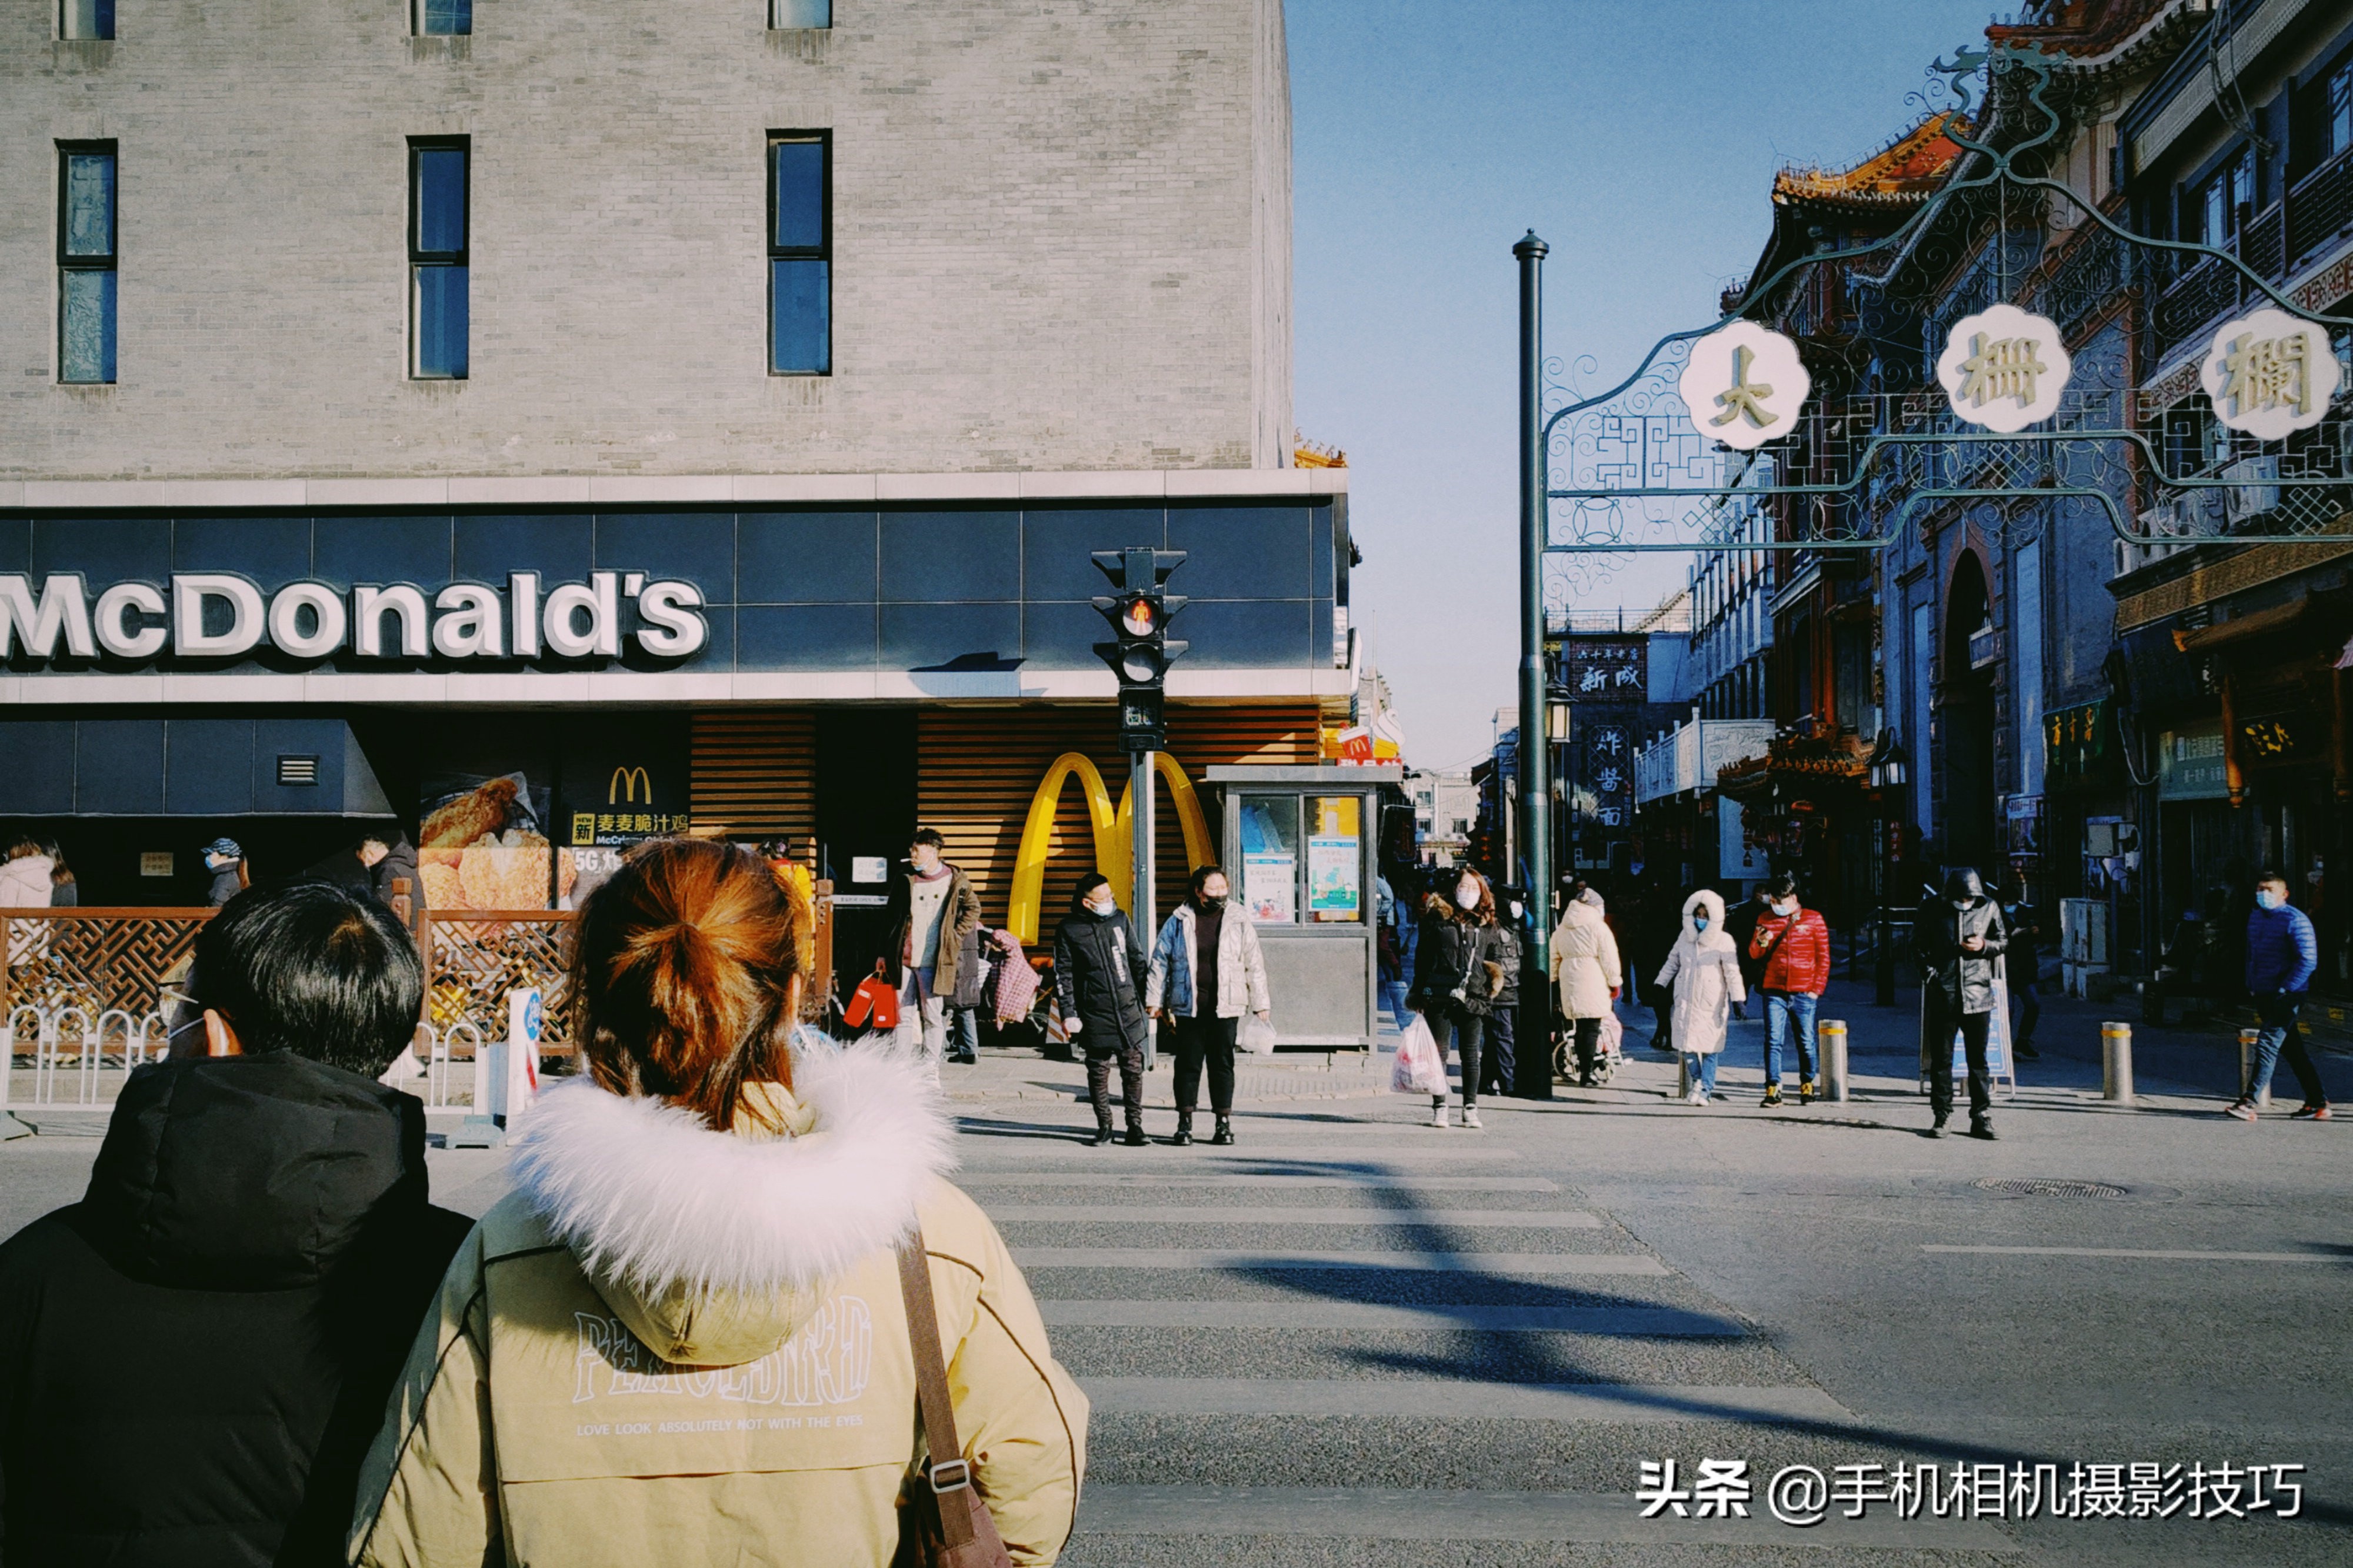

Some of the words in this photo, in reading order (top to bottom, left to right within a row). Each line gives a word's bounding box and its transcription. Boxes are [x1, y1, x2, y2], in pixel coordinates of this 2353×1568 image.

[0, 572, 704, 658] McDonald's
[1578, 648, 1638, 660] 六十年老店
[575, 824, 592, 840] 新
[598, 814, 688, 832] 麦麦脆汁鸡
[577, 1424, 610, 1436] LOVE
[615, 1423, 651, 1434] LOOK
[658, 1420, 732, 1434] ABSOLUTELY
[737, 1418, 763, 1430] NOT
[768, 1417, 801, 1429] WITH
[808, 1416, 830, 1428] THE
[836, 1414, 863, 1427] EYES
